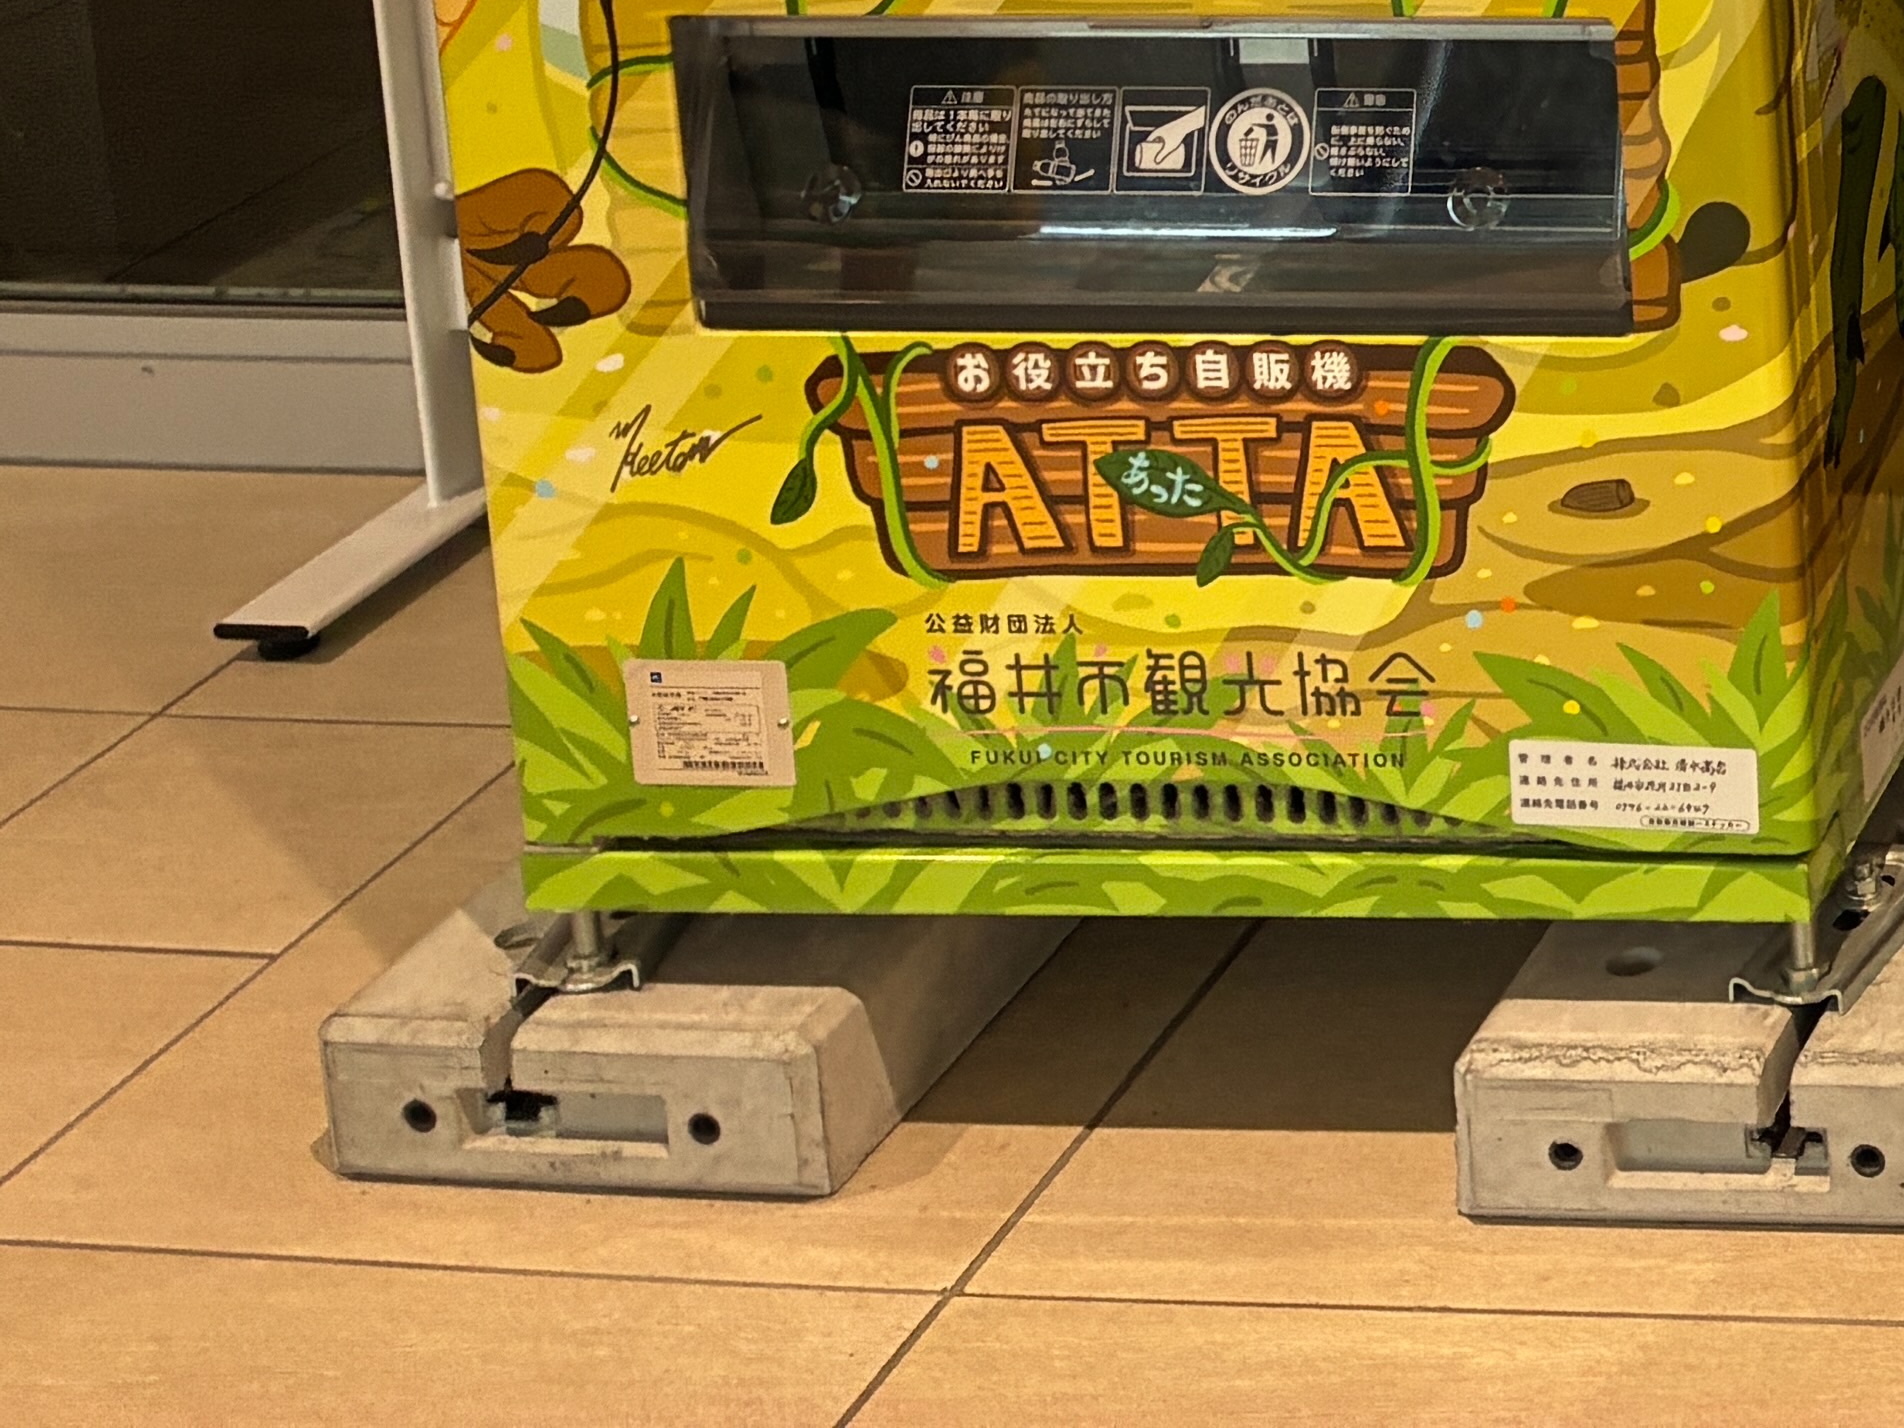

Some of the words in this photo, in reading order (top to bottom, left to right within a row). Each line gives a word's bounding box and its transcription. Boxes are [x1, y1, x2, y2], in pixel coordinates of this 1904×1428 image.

[955, 350, 1354, 394] お役立ち自販機
[956, 414, 1405, 556] ATTA
[1120, 450, 1206, 509] あった
[925, 612, 1086, 635] 公益財団法人
[927, 649, 1440, 718] 福井市観光協会
[970, 750, 1041, 768] FUKUI
[1046, 750, 1112, 768] CITY
[1121, 750, 1227, 769] TOURISM
[1233, 751, 1406, 771] ASSOCIATION
